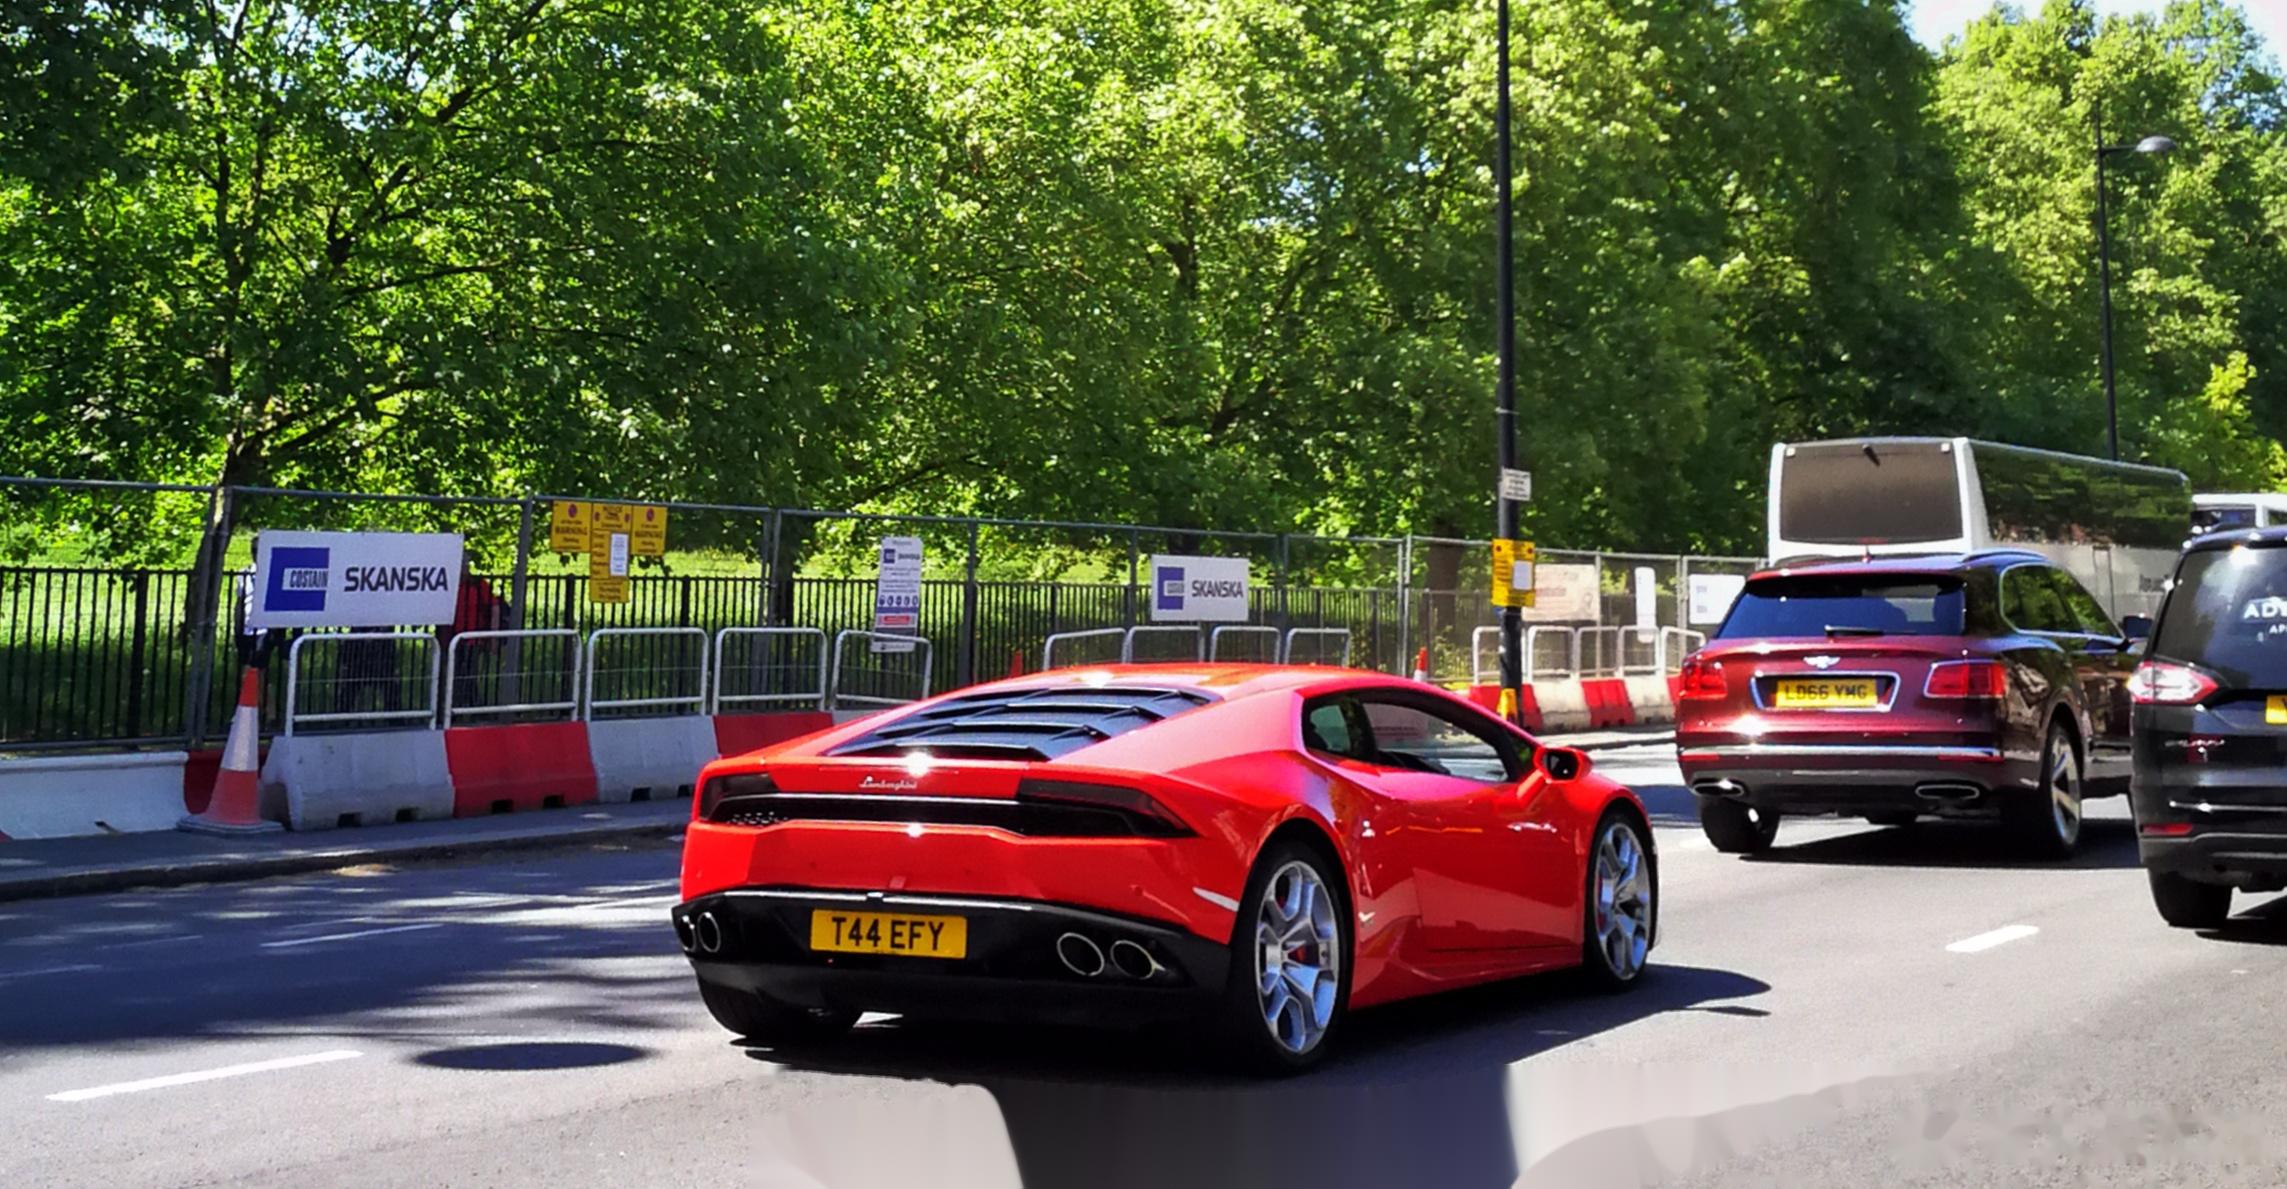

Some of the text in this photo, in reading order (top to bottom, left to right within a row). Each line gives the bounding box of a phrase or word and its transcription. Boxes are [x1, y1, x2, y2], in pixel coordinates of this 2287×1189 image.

[289, 570, 329, 588] COSTAIN
[344, 567, 448, 592] SKANSKA
[1191, 580, 1244, 598] SKANSKA
[1785, 684, 1829, 700] LD66
[832, 916, 945, 950] T44 EFY
